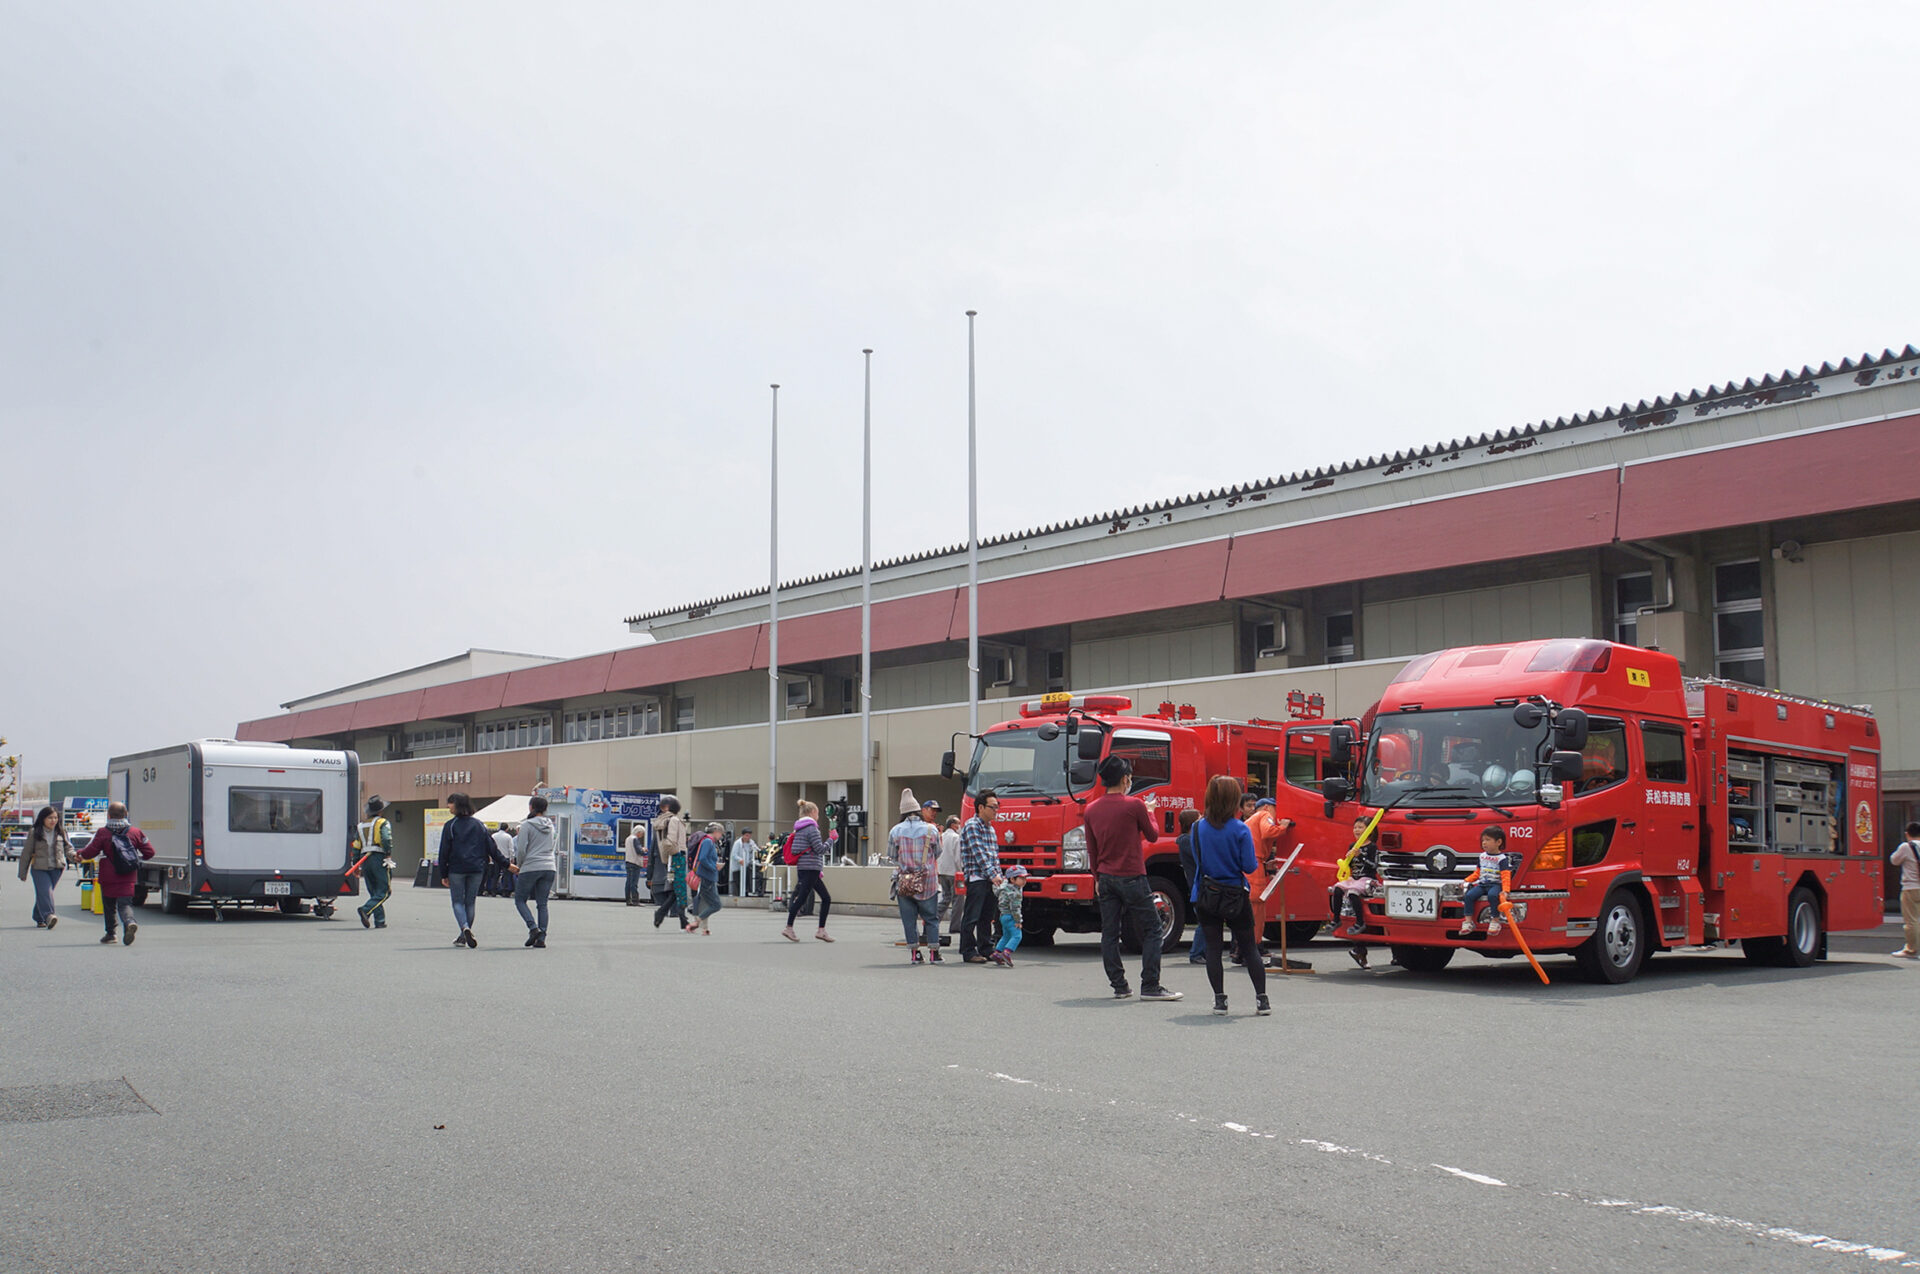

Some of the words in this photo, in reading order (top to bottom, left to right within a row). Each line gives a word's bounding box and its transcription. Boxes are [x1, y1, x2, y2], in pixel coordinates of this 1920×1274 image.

[1143, 794, 1195, 809] 松市消防局
[1645, 788, 1692, 807] 浜松市消防局
[995, 812, 1031, 821] ISUZU
[1509, 826, 1534, 838] R02
[1677, 859, 1690, 871] H24
